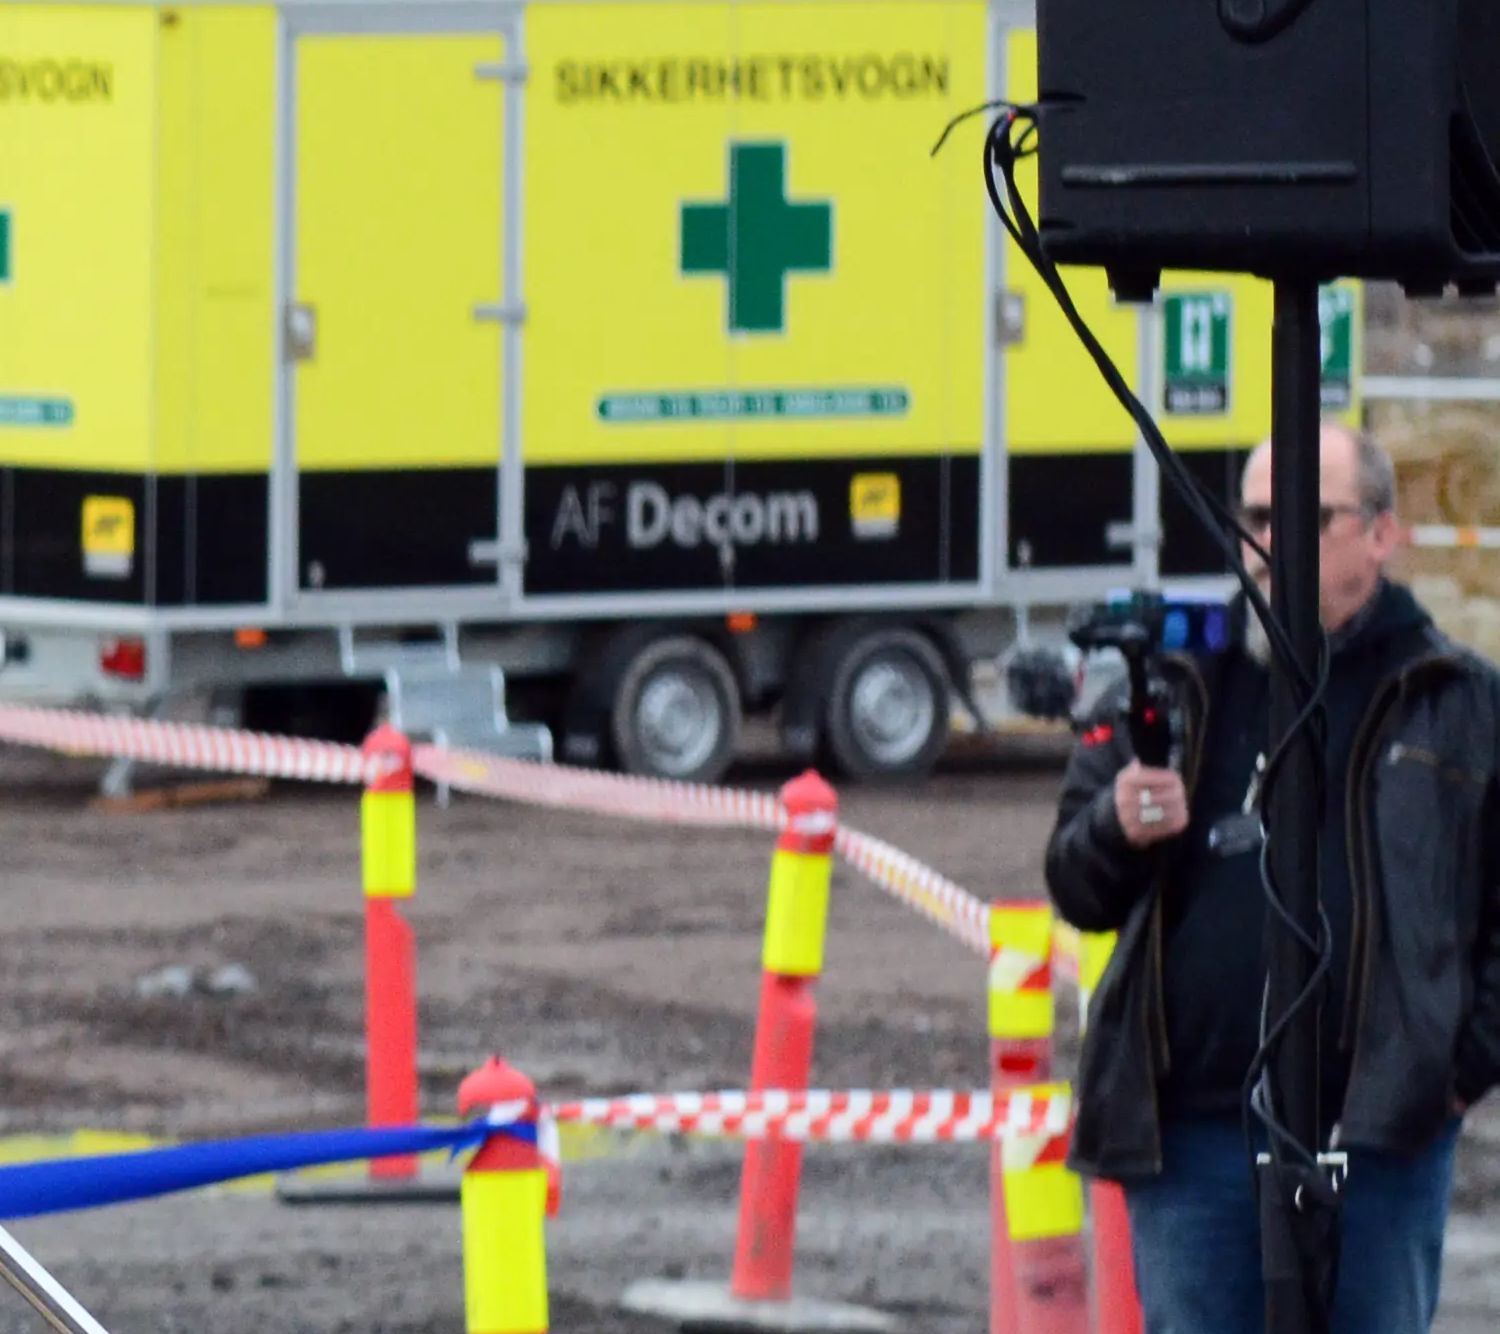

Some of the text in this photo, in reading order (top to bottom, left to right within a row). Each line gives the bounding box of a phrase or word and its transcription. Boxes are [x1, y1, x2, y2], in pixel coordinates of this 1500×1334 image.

[555, 56, 951, 104] SIKKERHETSVOGN
[551, 479, 819, 551] AF Decom
